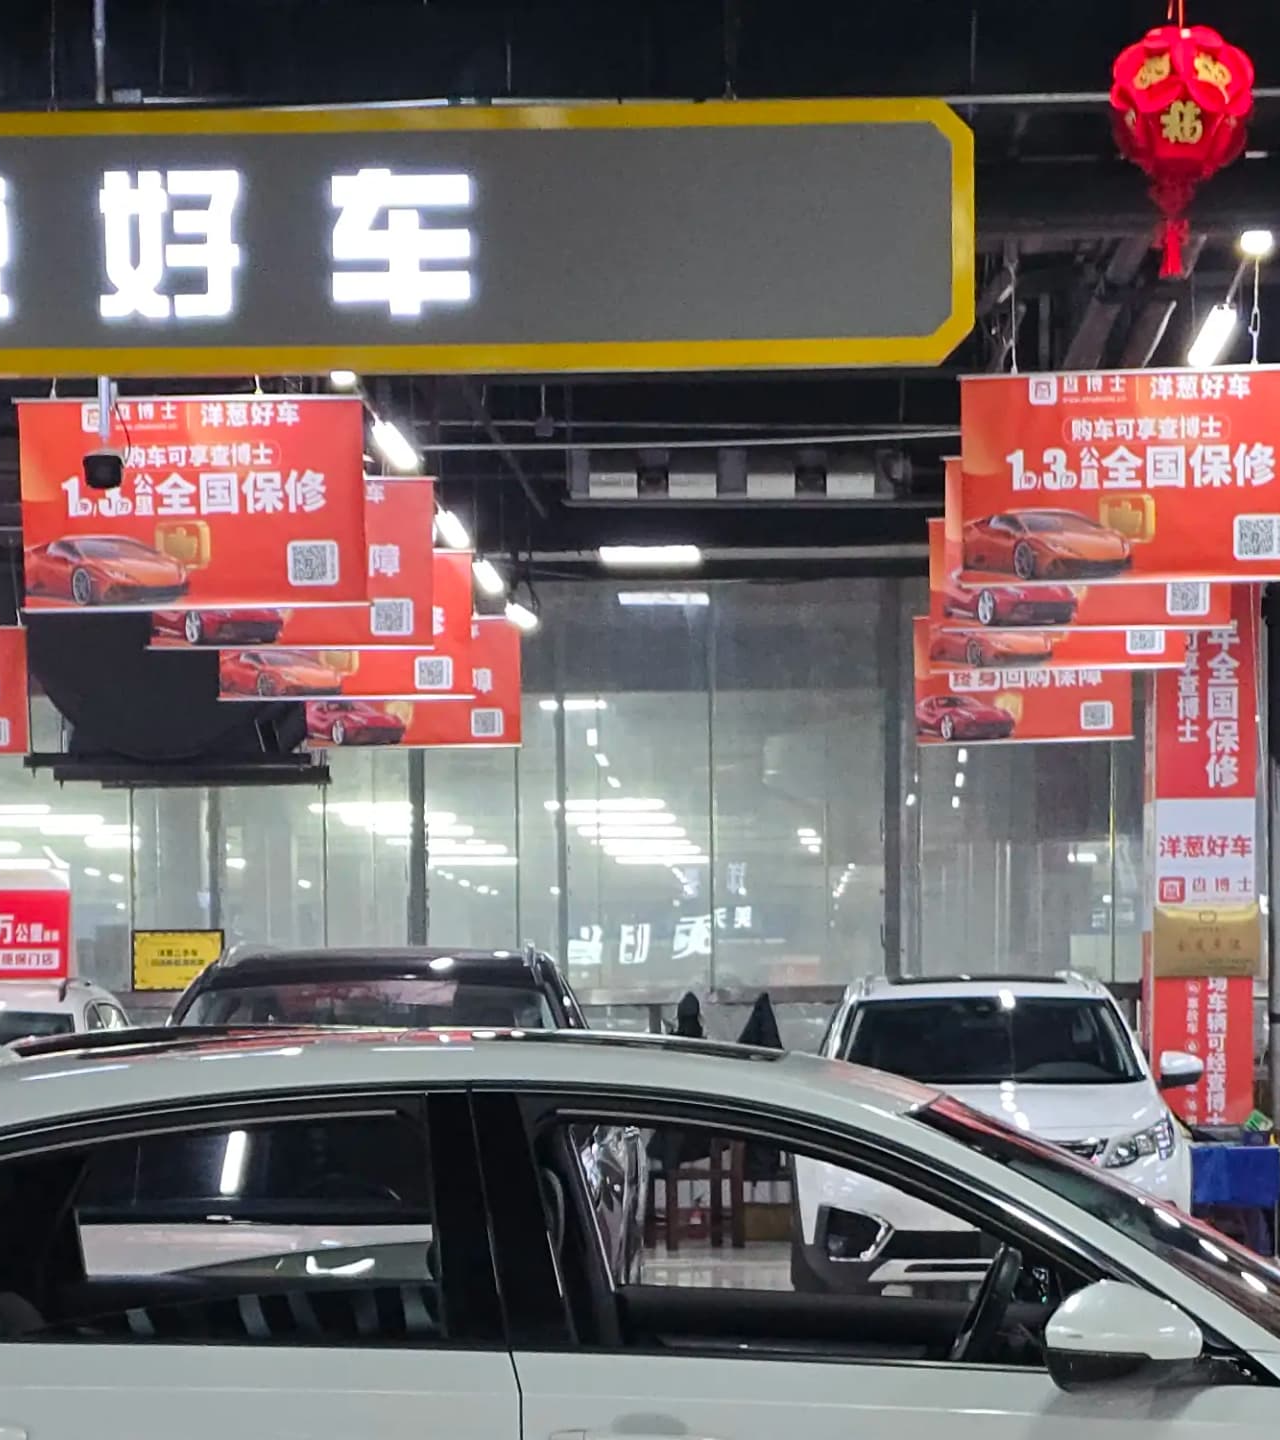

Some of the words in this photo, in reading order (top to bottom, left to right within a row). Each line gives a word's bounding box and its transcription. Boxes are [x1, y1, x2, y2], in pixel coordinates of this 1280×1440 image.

[1150, 374, 1251, 401] 洋葱好车
[201, 402, 300, 427] 洋葱好车
[1071, 415, 1222, 442] 购车可享查博士
[125, 443, 273, 468] 购车可享查博士
[1159, 834, 1253, 859] 洋葱好车
